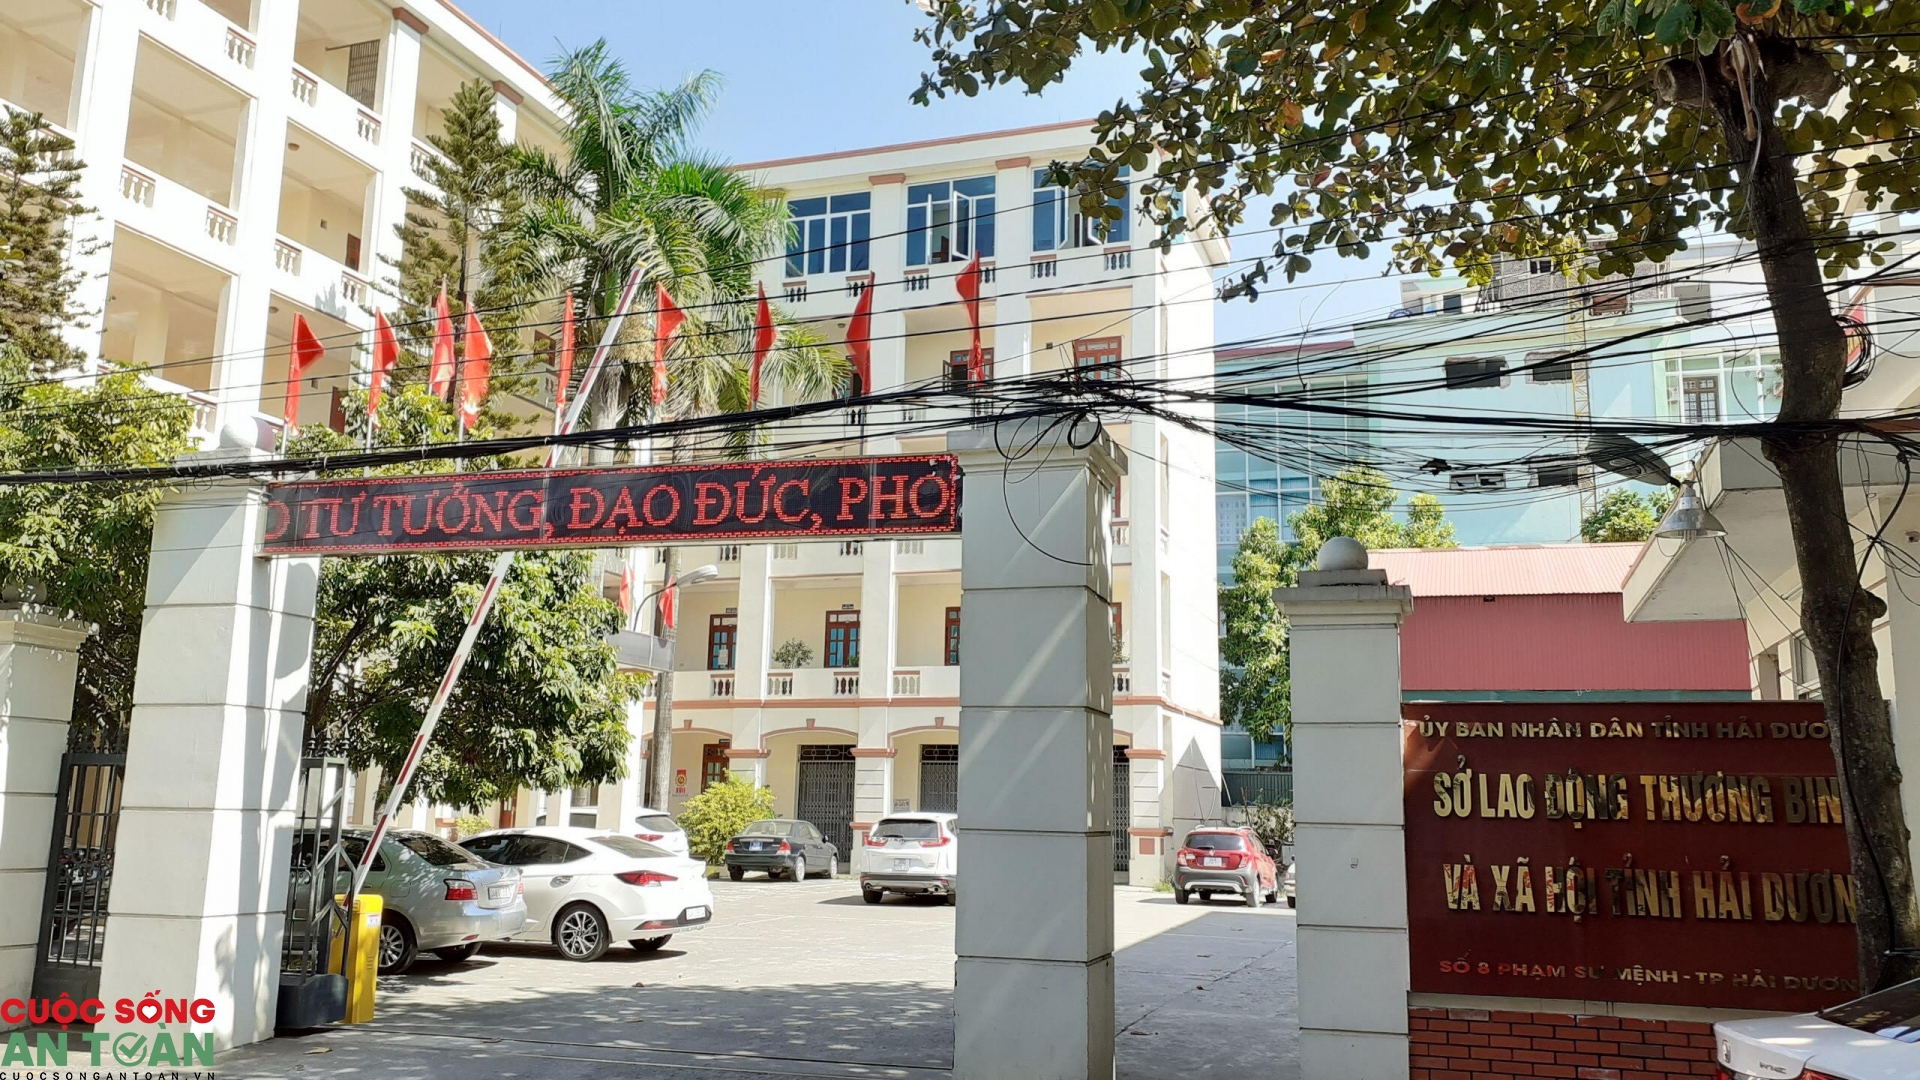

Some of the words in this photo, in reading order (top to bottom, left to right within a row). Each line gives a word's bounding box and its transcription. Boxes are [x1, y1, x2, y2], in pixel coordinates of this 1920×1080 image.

[301, 491, 366, 538] TƯ
[373, 482, 554, 542] TƯỞNG,
[568, 484, 680, 534] ĐẠO
[693, 467, 822, 531] ĐỨC,
[1419, 715, 1450, 738] ỦY
[1455, 721, 1504, 738] BAN
[1511, 717, 1582, 738] NHÂN
[1590, 717, 1643, 738] DÂN
[1651, 715, 1709, 738] TỈNH
[1716, 716, 1763, 739] HẢI
[1433, 755, 1472, 818] SỞ
[1478, 773, 1536, 819] LAO
[1545, 767, 1629, 829] ĐỘNG
[1640, 771, 1774, 823] THƯƠNG
[1782, 776, 1843, 823] BIN
[1442, 854, 1481, 911] VÀ
[1491, 856, 1536, 913] XÃ
[1545, 856, 1598, 923] HỘI
[1605, 853, 1682, 918] TỈNH
[1692, 855, 1753, 920] HẢI
[1761, 868, 1858, 924] DƯƠN
[1439, 949, 1471, 974] SỐ
[1477, 962, 1490, 975] 8
[1498, 963, 1566, 981] PHẠM
[1614, 965, 1679, 985] MỆNH
[1695, 972, 1724, 985] TP
[1732, 969, 1777, 988] HẢI
[1783, 976, 1861, 992] DƯƠN
